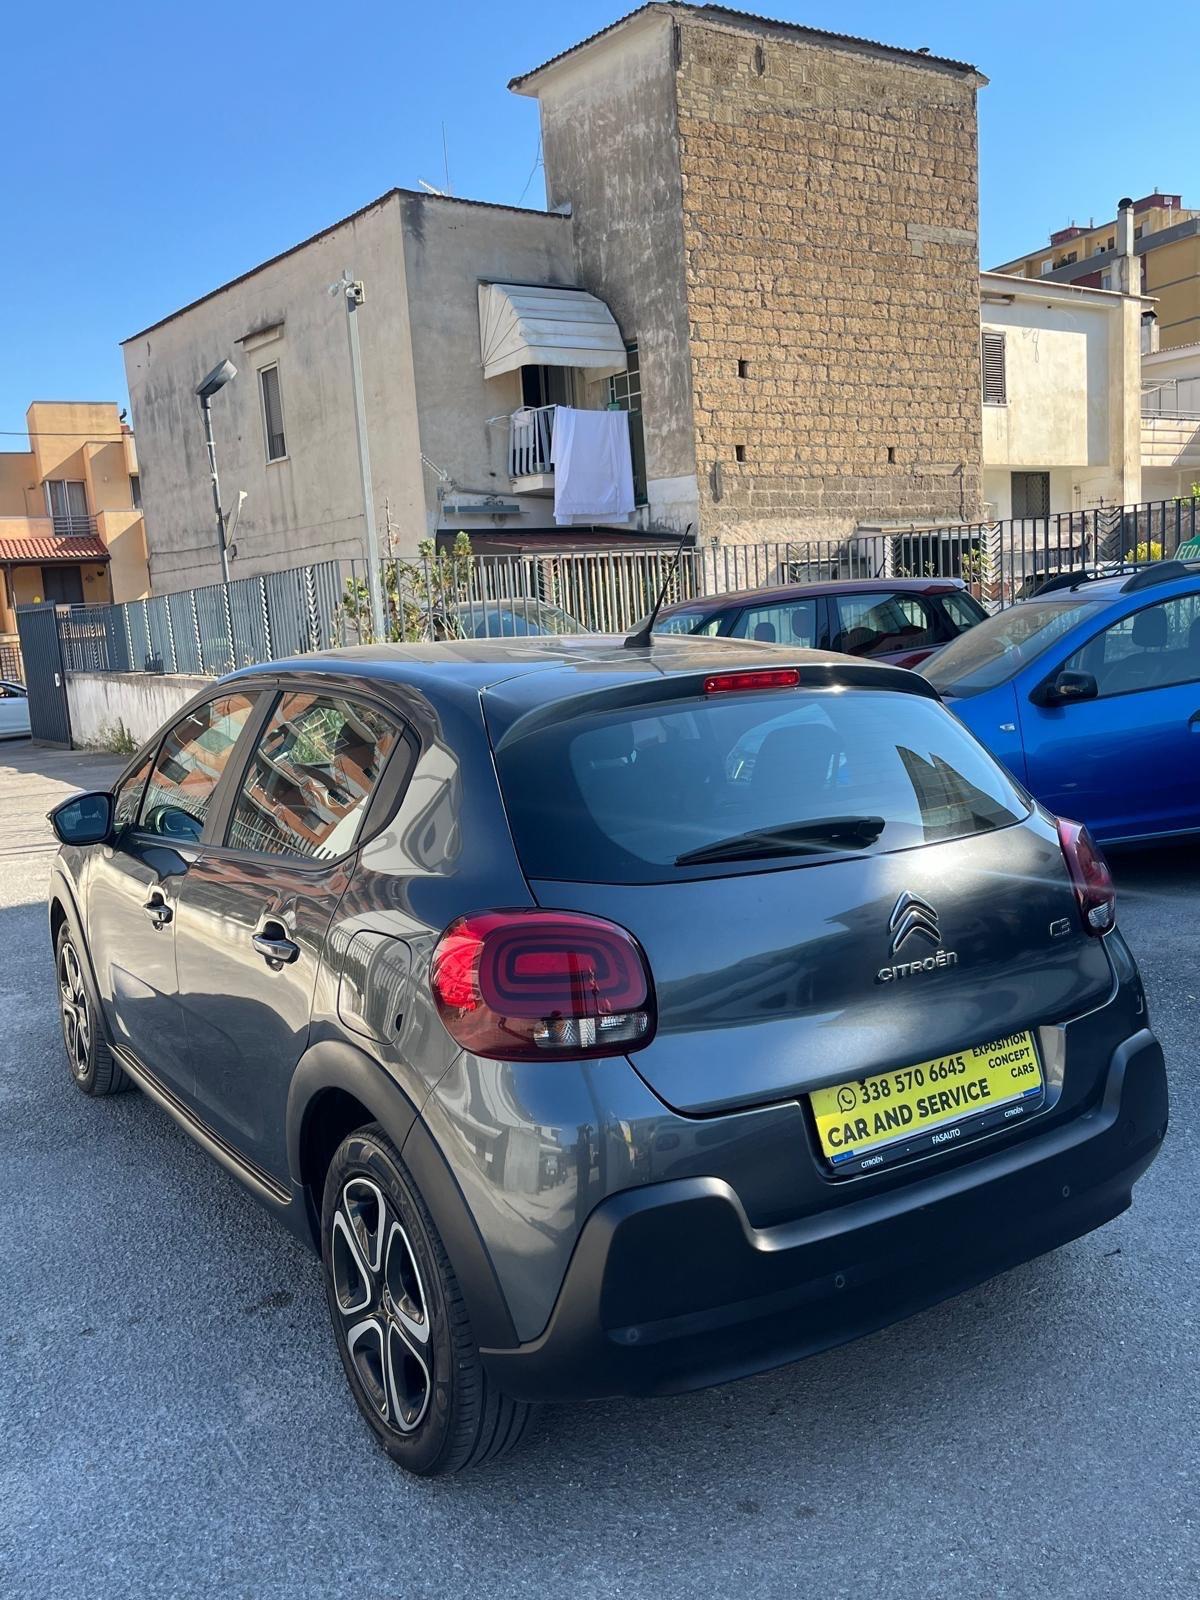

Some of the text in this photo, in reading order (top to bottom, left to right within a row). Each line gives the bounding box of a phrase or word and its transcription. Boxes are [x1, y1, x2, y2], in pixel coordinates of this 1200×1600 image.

[972, 1032, 1027, 1058] EXPOSITION
[988, 1047, 1031, 1069] CONCEPT
[859, 1056, 966, 1104] 338 570 6645
[1010, 1062, 1035, 1079] CARS
[827, 1078, 991, 1148] CAR AND SERVICE
[931, 1128, 961, 1144] FASAUTO
